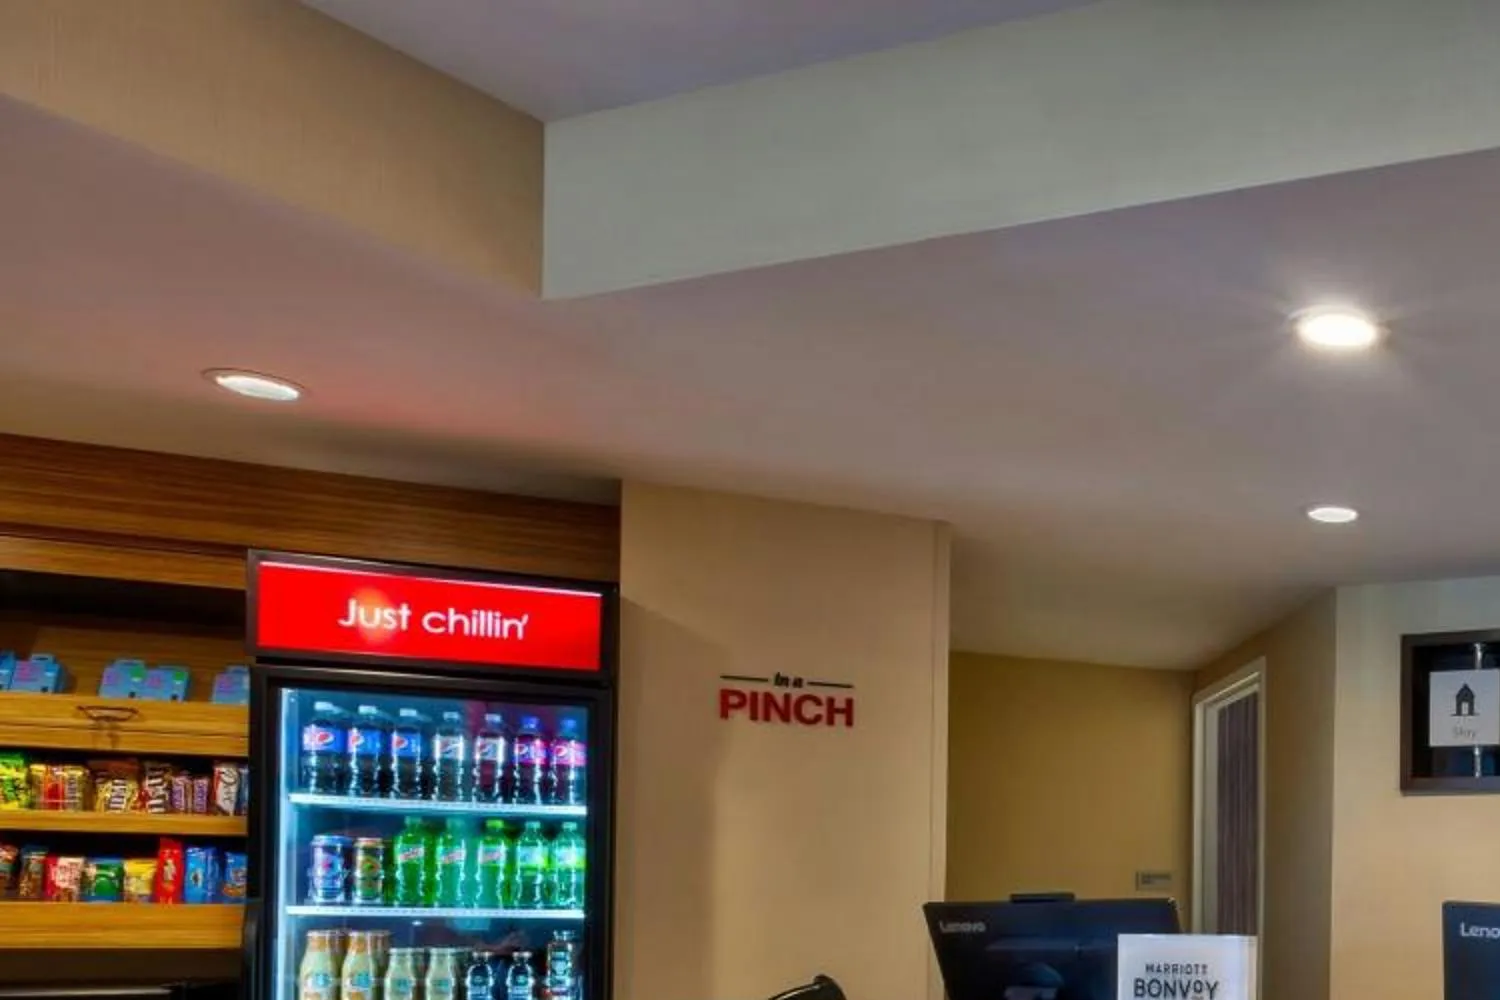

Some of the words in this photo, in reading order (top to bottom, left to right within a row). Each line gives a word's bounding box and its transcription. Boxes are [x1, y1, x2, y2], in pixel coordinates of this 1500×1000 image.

[338, 598, 411, 631] Just
[720, 688, 854, 727] PINCH
[1145, 963, 1208, 975] MARRIOTT
